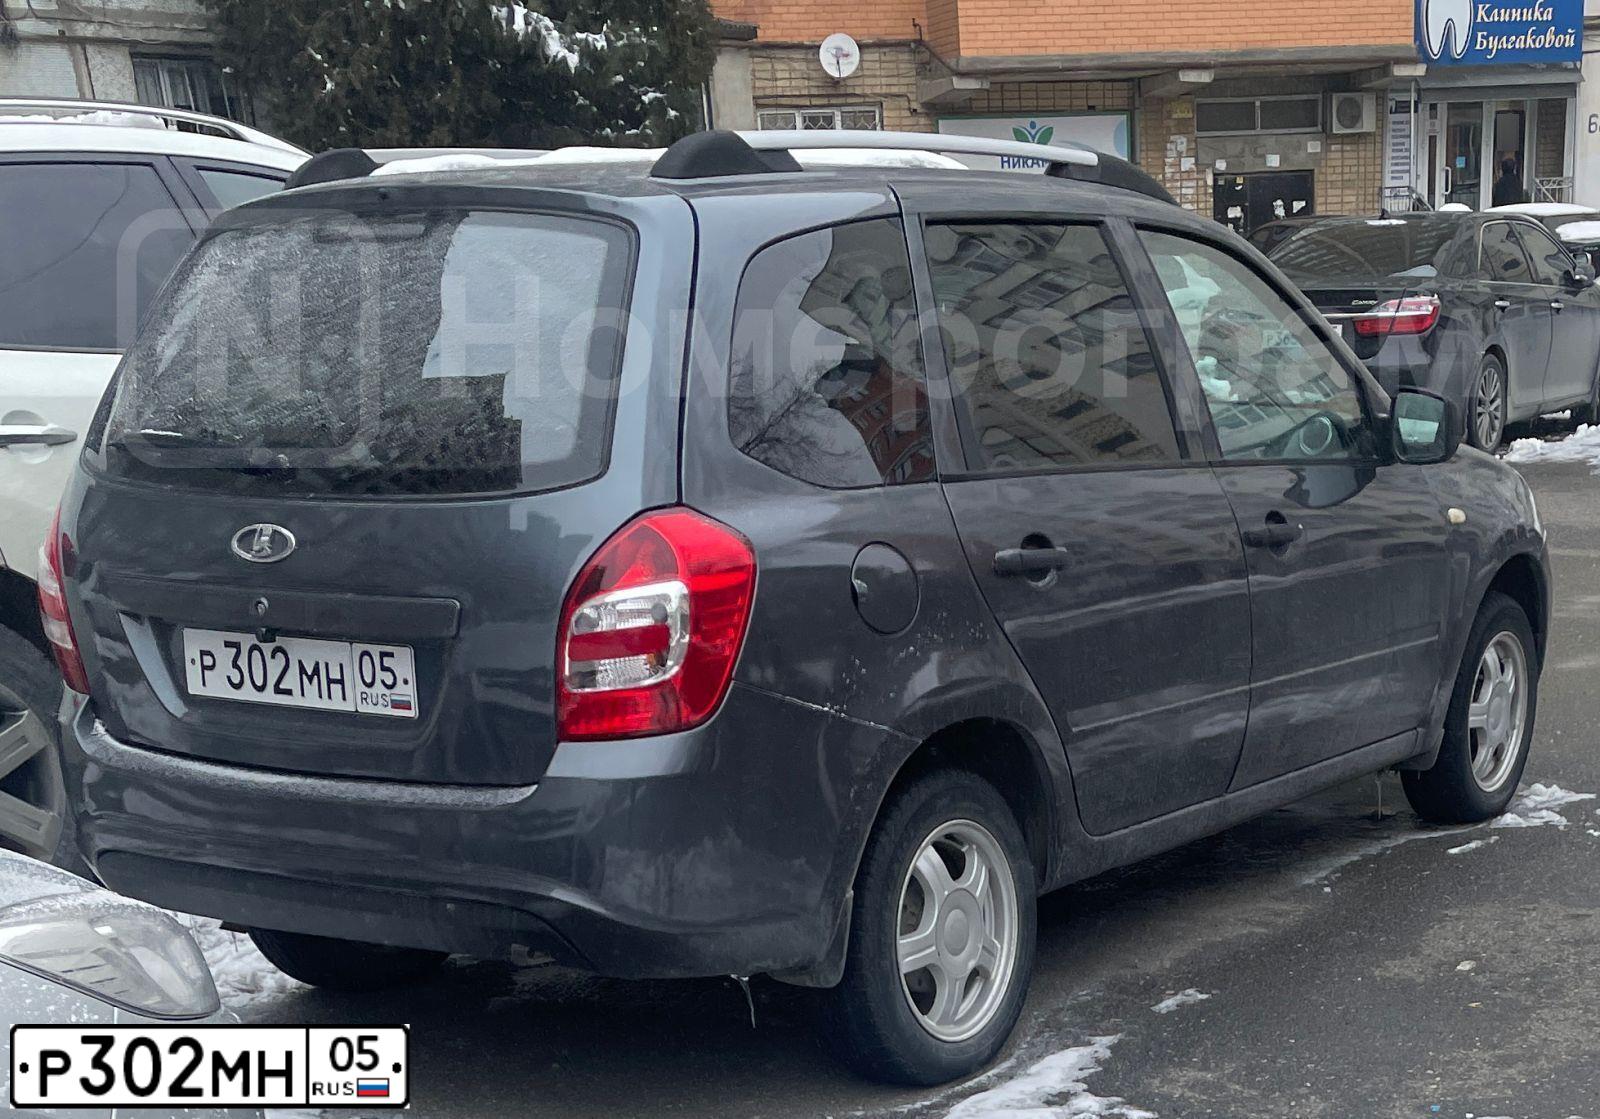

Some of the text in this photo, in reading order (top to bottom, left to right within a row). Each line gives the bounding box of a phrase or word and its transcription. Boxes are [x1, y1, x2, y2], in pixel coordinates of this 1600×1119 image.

[1476, 0, 1553, 22] Клиника
[1475, 27, 1576, 59] Булгаковой
[199, 640, 397, 701] Р302МН 05
[360, 691, 389, 707] RUS
